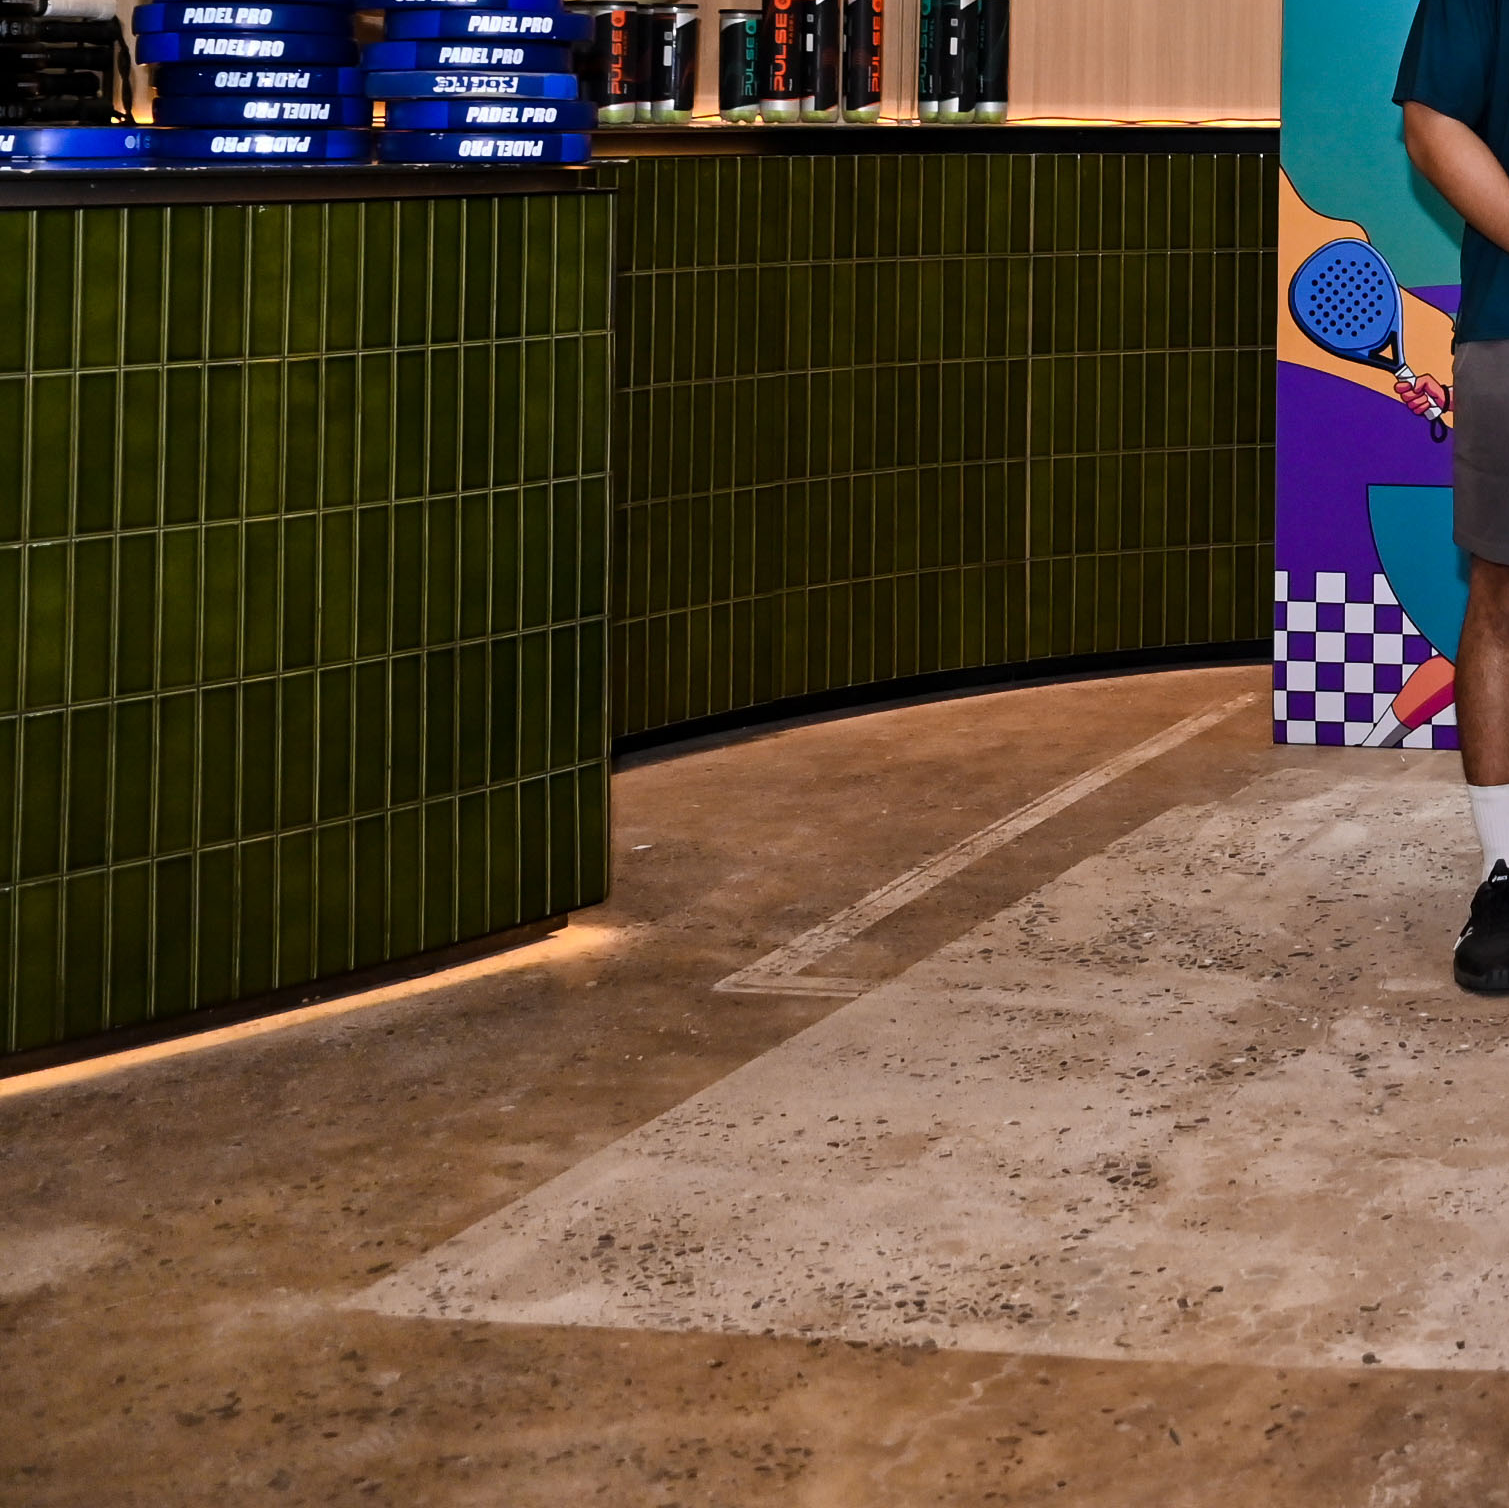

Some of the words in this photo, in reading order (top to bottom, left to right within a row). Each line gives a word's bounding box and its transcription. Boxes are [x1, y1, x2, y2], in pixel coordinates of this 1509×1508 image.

[183, 8, 233, 24] PADEL
[235, 8, 272, 24] PRO
[468, 16, 518, 33] PADEL
[520, 17, 553, 33] PRO
[194, 39, 245, 56] PADEL
[247, 40, 284, 57] PRO
[439, 47, 488, 64] PADEL
[491, 48, 524, 64] PRO
[773, 13, 788, 92] PULSE
[611, 30, 624, 94] PULSE
[745, 36, 756, 96] PULSE
[215, 72, 252, 87] PRO
[256, 72, 310, 88] PADEL
[244, 102, 279, 118] PRO
[283, 103, 330, 119] PADEL
[466, 107, 518, 123] PADEL
[521, 108, 557, 123] PRO
[211, 137, 251, 153] PRO
[255, 137, 310, 153] PADEL
[459, 141, 495, 156] PRO
[497, 141, 543, 156] PADEL
